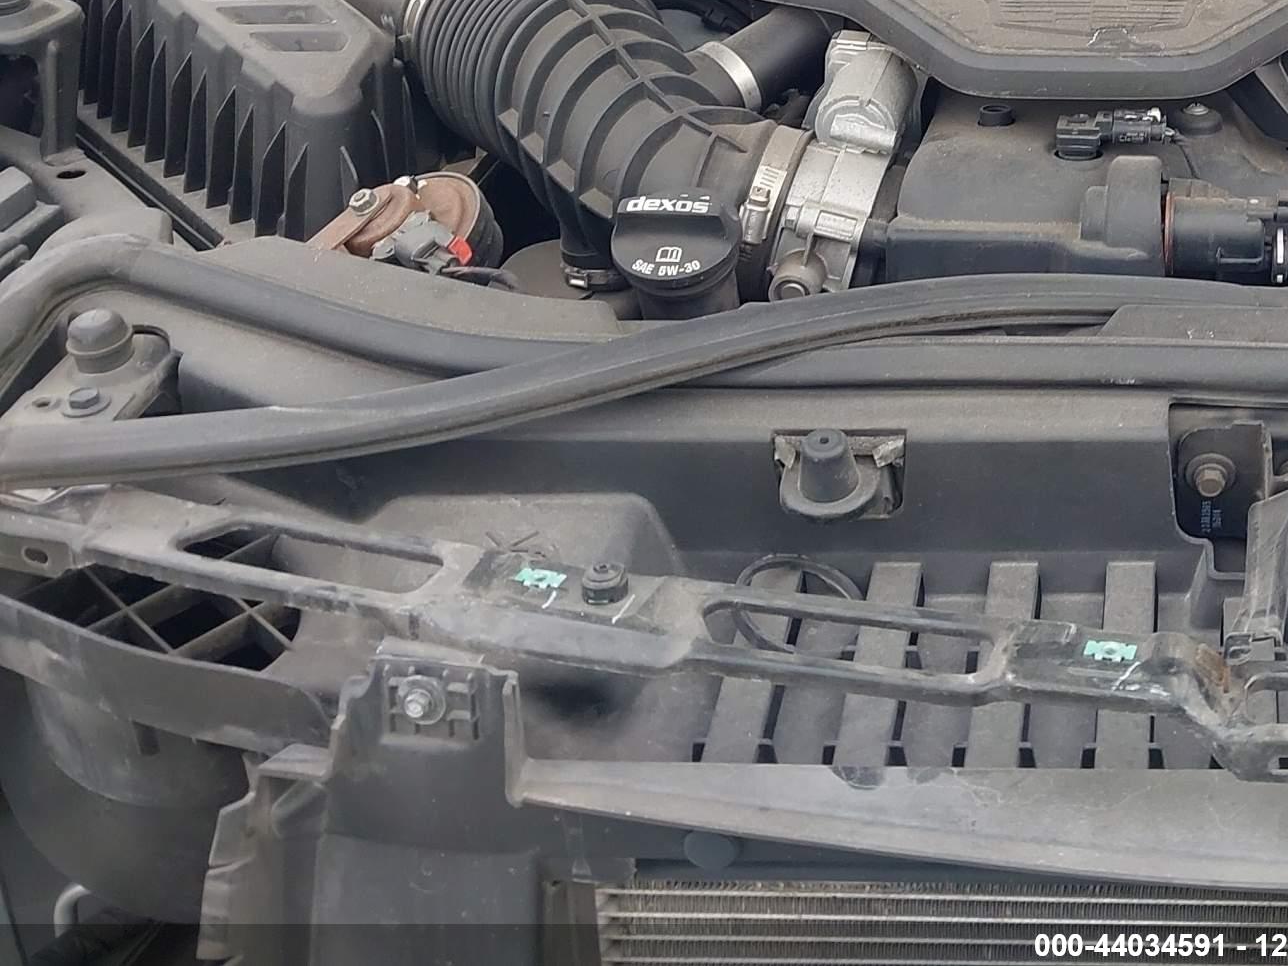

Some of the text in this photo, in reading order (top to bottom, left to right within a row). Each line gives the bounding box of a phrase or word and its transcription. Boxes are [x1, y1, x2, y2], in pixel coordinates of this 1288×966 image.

[626, 196, 710, 213] dexos
[632, 259, 701, 276] SAE 5W-30
